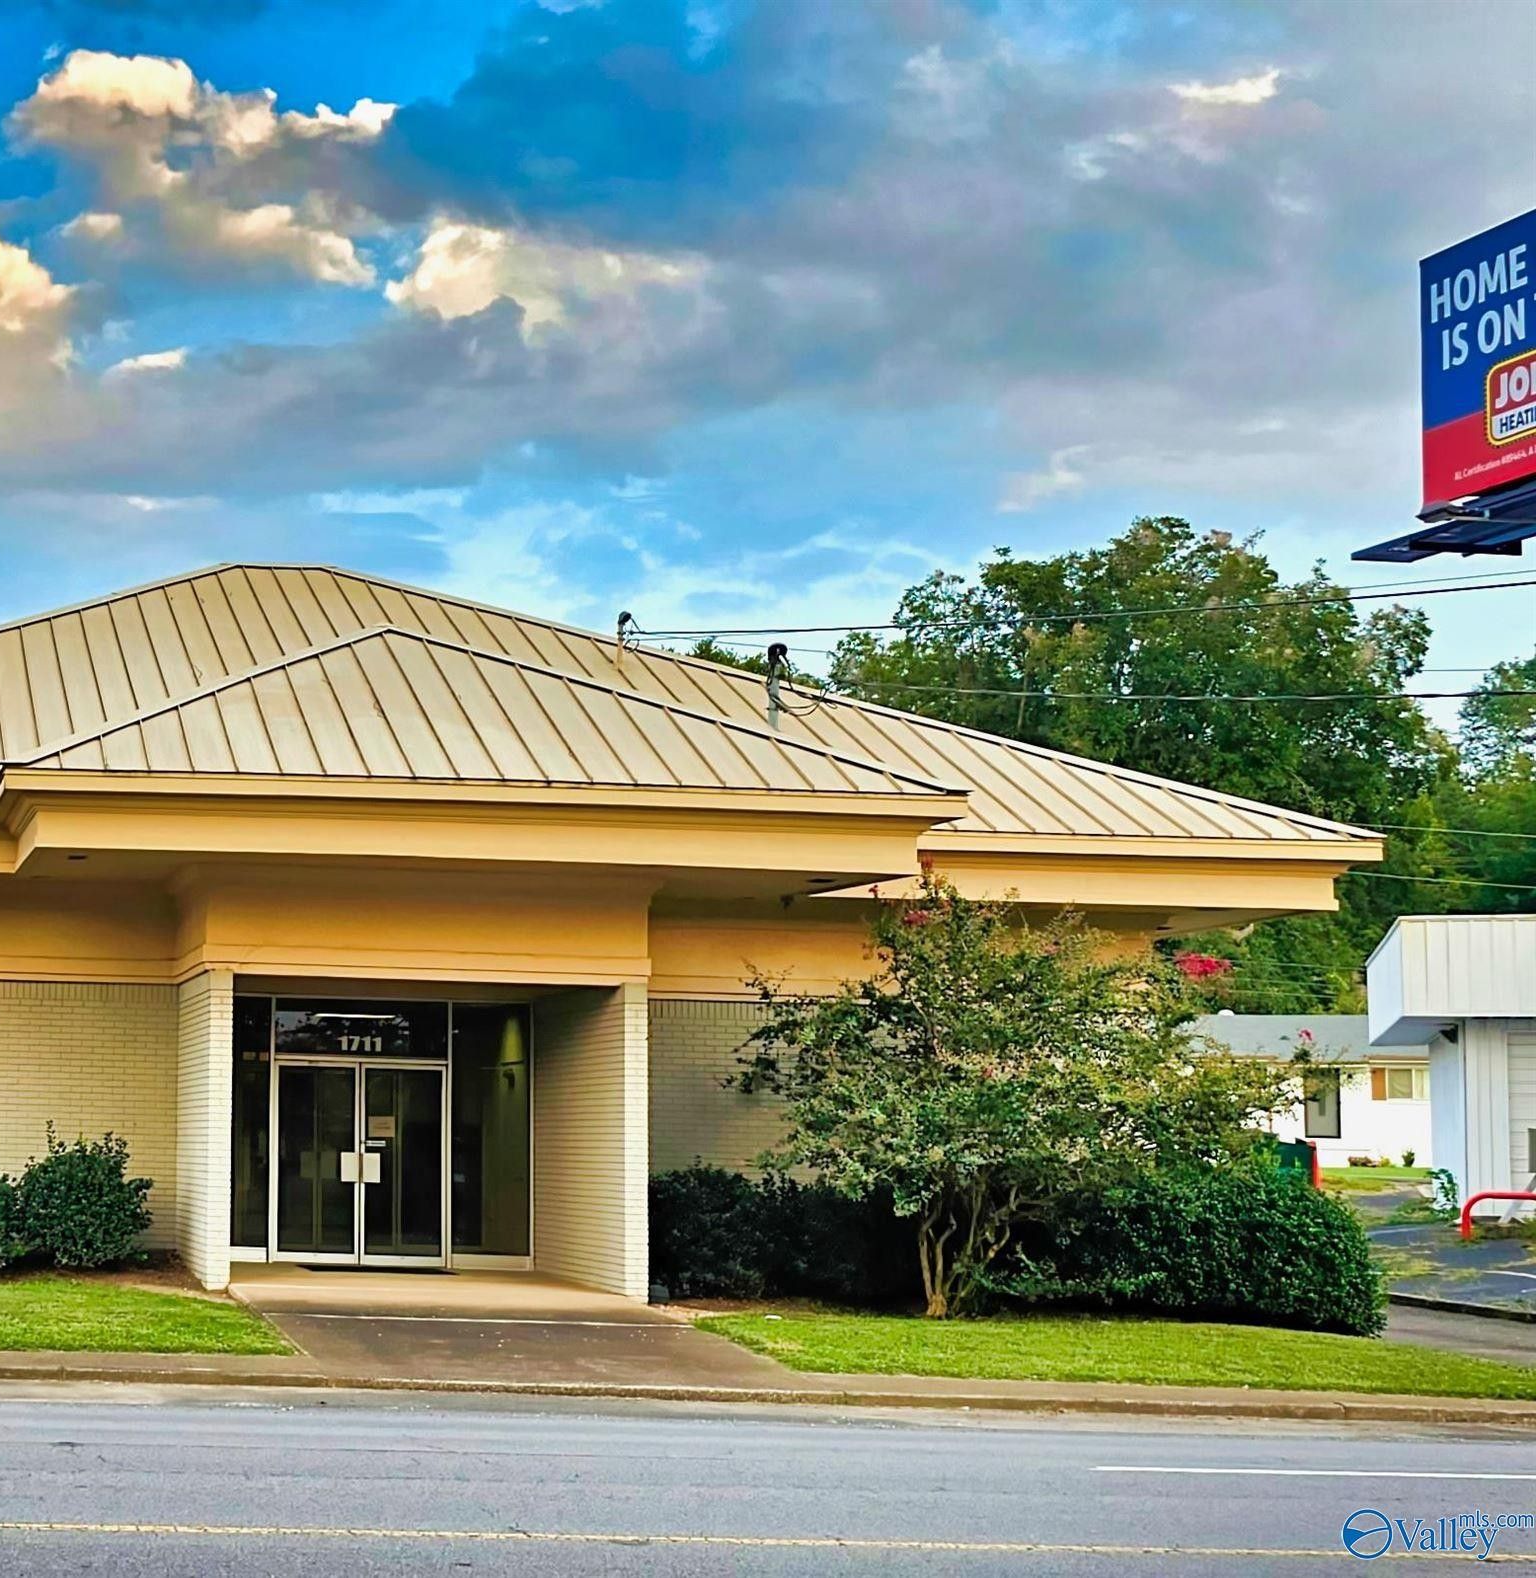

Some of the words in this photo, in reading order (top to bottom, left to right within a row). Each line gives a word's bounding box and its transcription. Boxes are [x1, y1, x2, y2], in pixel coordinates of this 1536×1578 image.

[1430, 243, 1528, 324] HOME
[1441, 322, 1469, 371] IS
[1477, 298, 1526, 354] ON
[1499, 405, 1536, 434] HEATI
[337, 1035, 382, 1052] 1711
